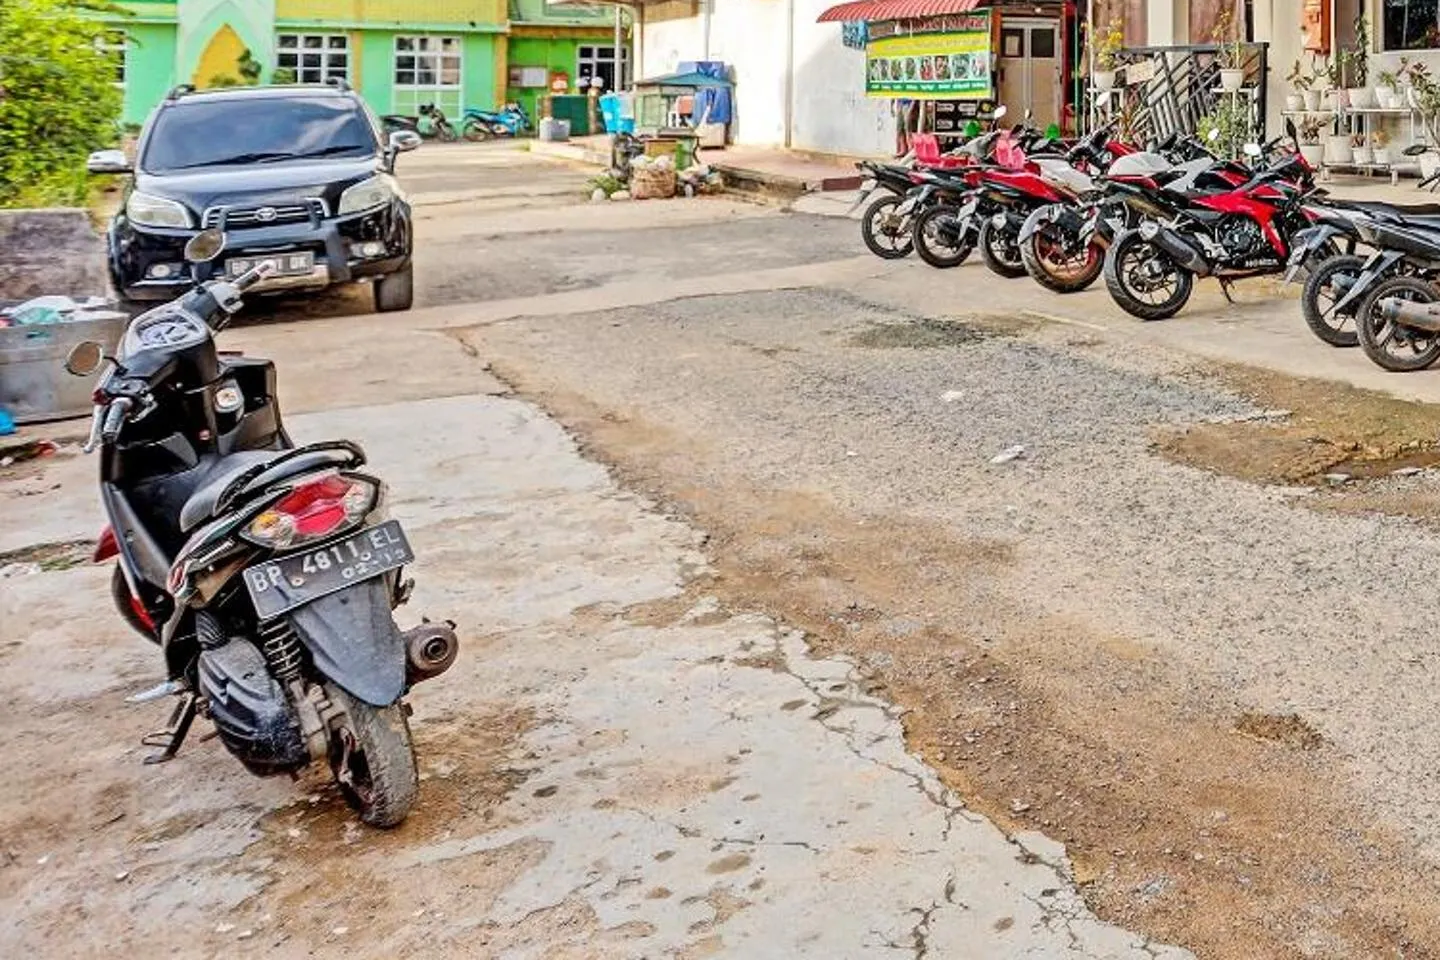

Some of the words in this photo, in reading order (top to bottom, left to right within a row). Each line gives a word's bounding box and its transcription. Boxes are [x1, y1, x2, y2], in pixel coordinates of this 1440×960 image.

[251, 565, 283, 593] BP
[302, 540, 359, 574] 4811
[369, 527, 401, 550] EL
